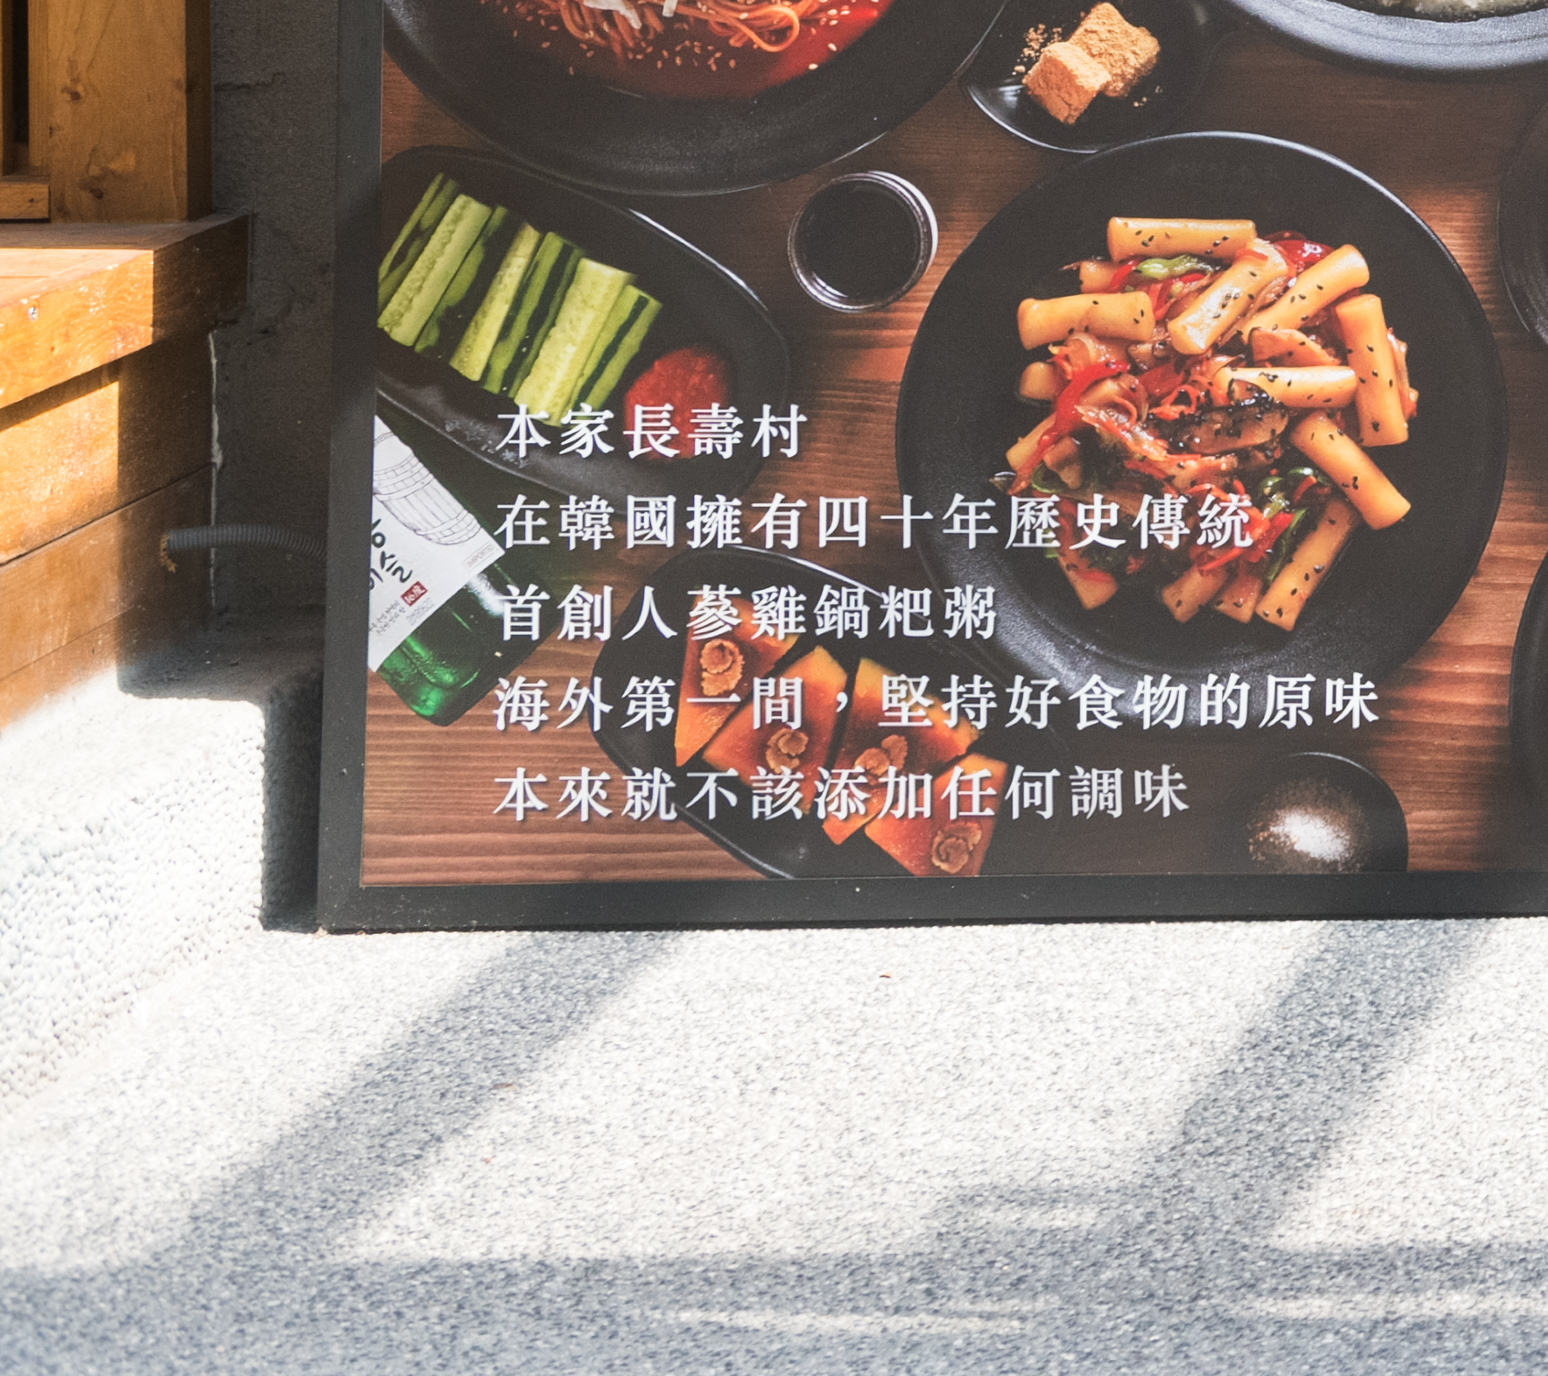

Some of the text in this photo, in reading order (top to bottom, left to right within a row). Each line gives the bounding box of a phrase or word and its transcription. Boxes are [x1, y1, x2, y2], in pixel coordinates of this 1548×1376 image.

[494, 401, 808, 460] 本家長壽村
[494, 492, 1254, 552] 在韓國擁有四十年歷史傳統
[496, 583, 999, 643] 首創人蔘雞鍋粑粥
[492, 674, 1381, 733] 海外第一間，堅持好食物的原味
[492, 764, 1190, 823] 本來就不該添加任何調味
